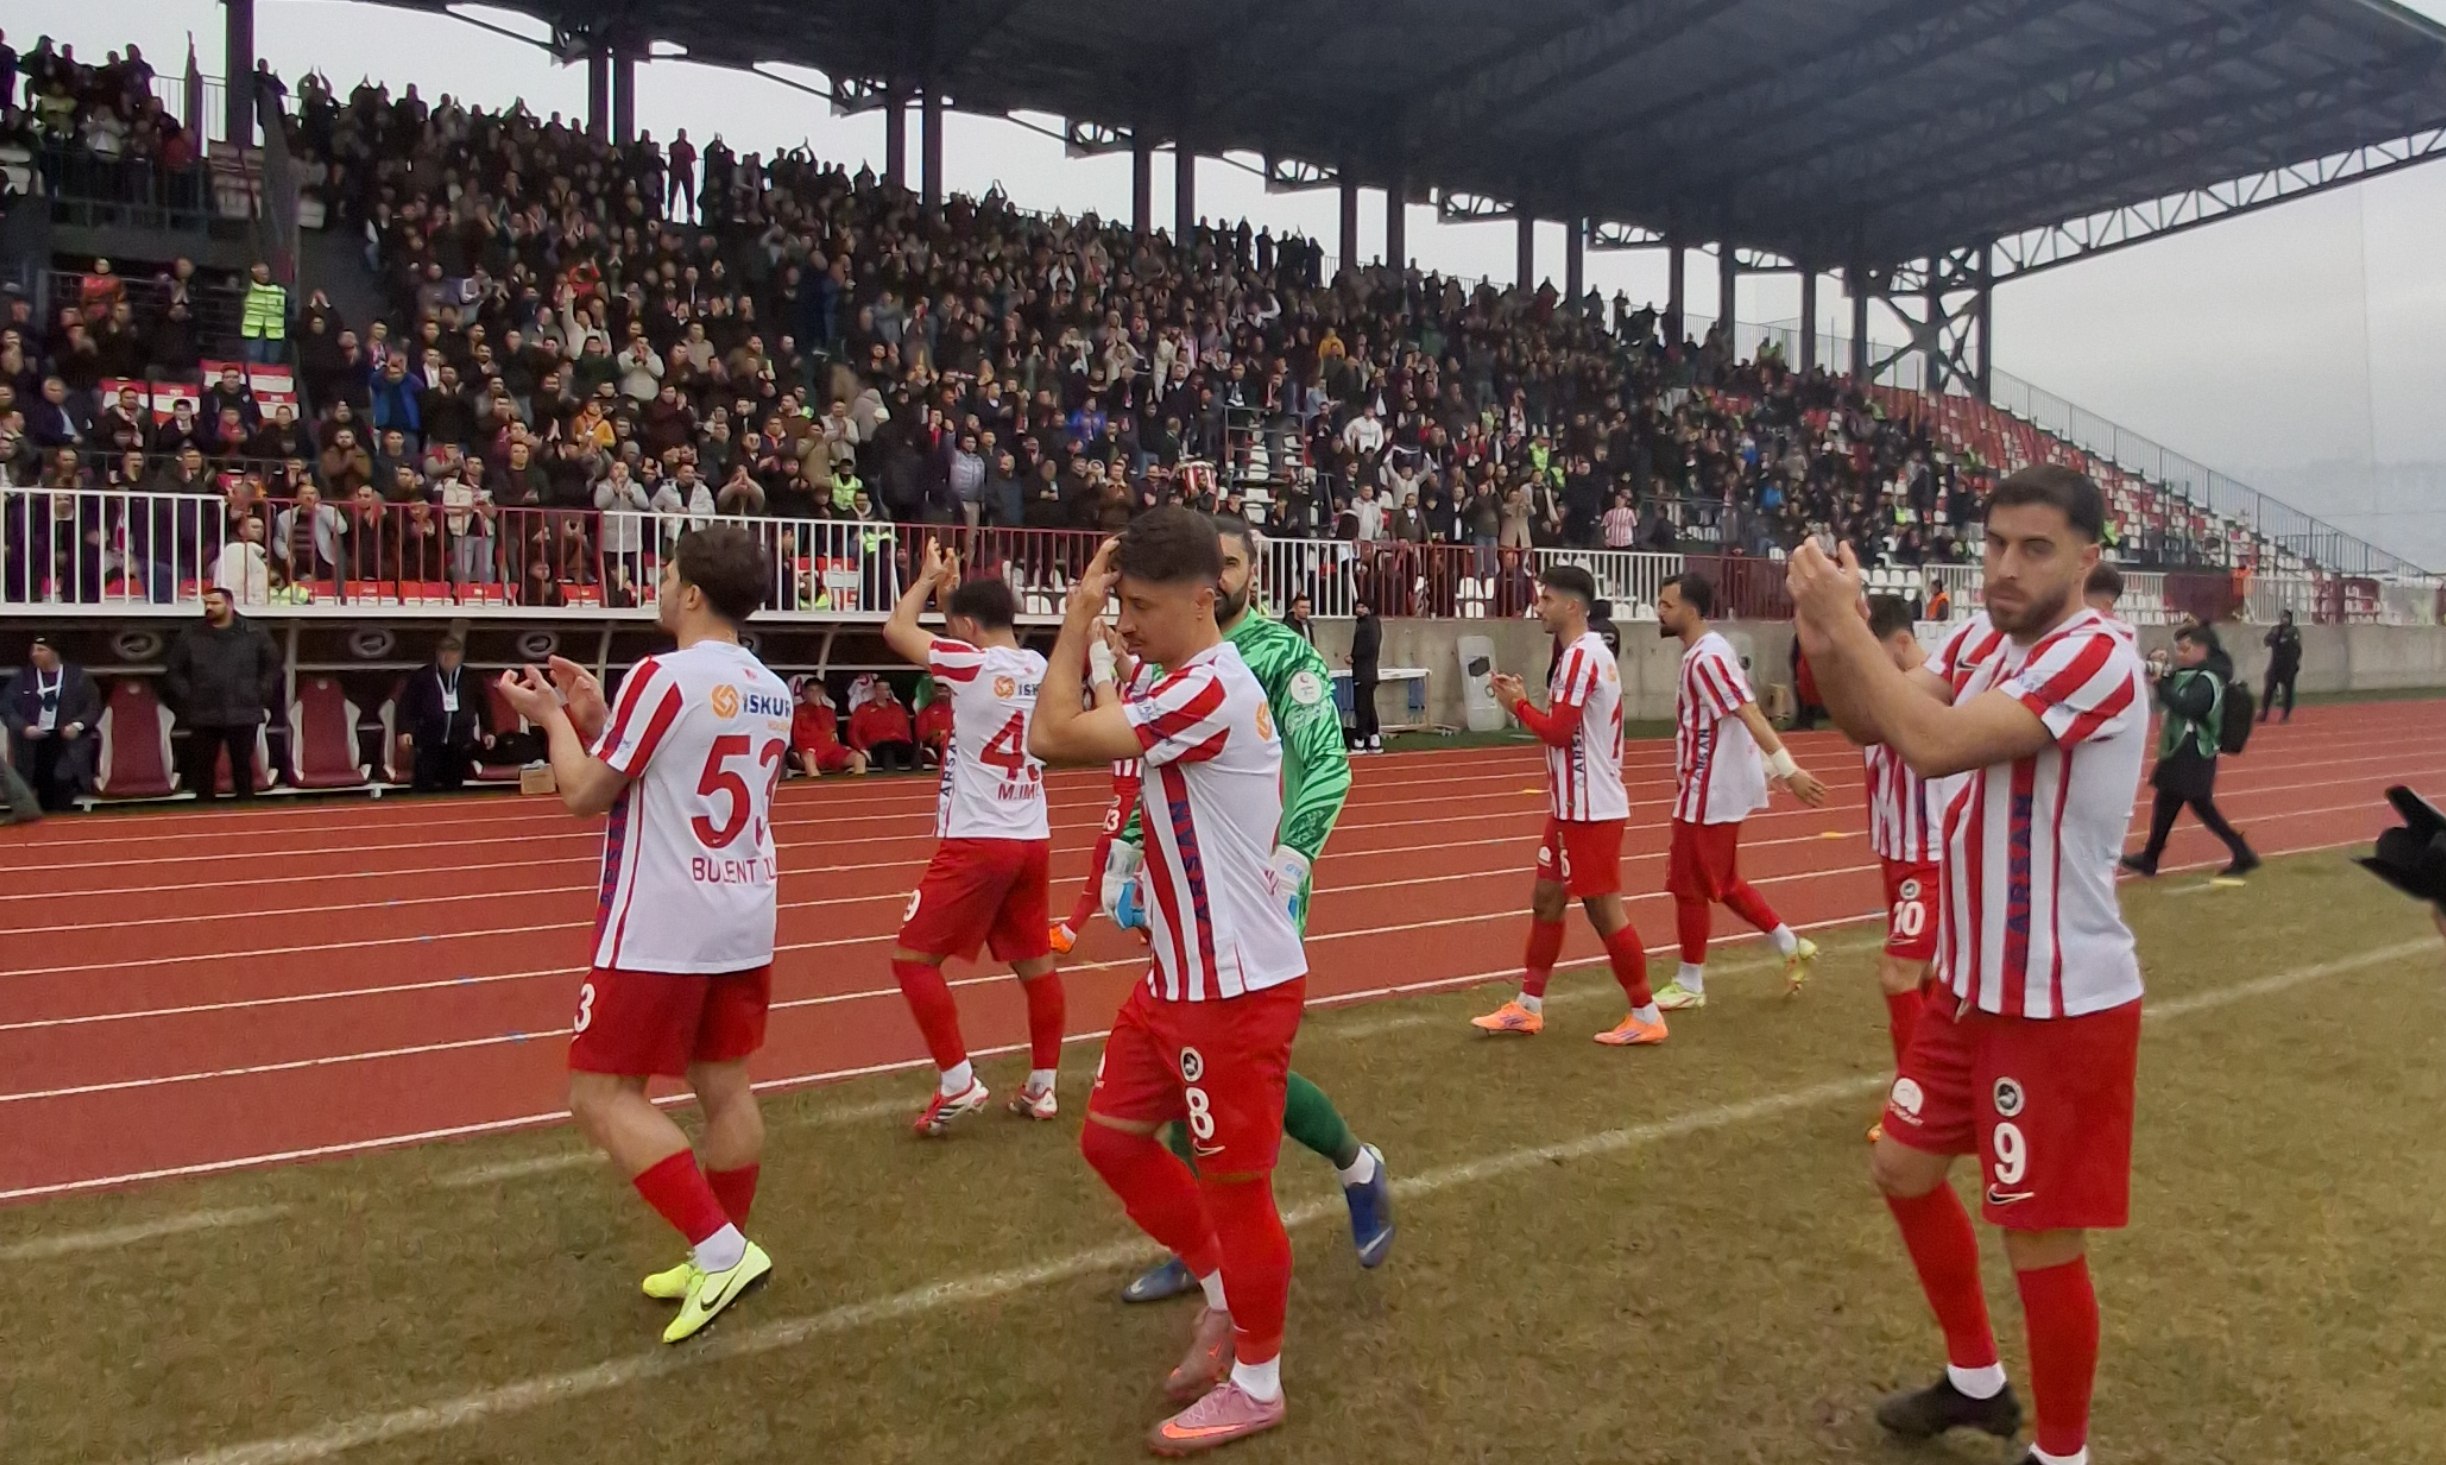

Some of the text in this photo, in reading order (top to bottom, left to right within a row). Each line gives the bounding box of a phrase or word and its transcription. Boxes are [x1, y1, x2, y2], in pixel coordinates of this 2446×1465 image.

[1893, 901, 1926, 936] 10
[574, 983, 595, 1033] 3
[1186, 1086, 1215, 1140] 8
[1993, 1122, 2027, 1185] 9
